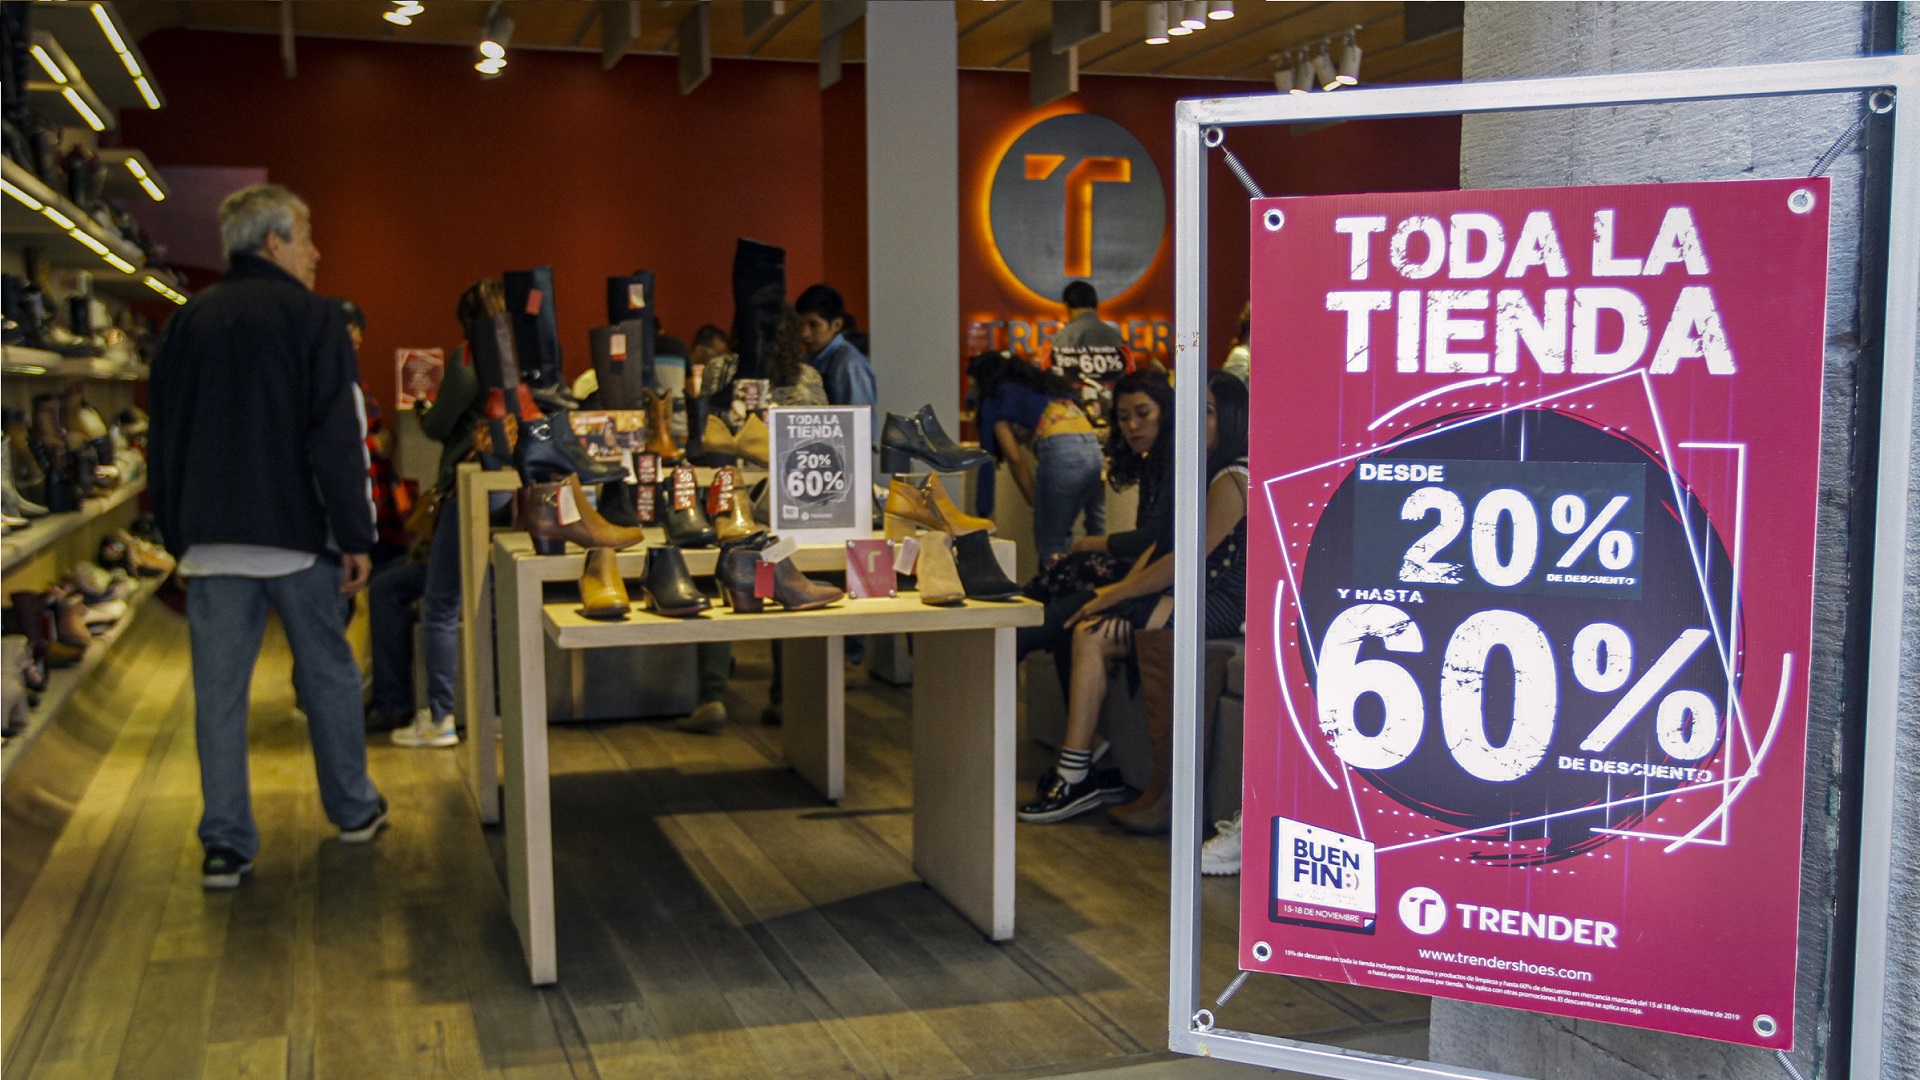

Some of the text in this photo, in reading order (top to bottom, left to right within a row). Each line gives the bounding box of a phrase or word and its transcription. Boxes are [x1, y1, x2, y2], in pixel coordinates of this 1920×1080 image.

[1335, 207, 1711, 280] TODA LA
[1326, 287, 1737, 375] TIENDA
[1079, 354, 1123, 374] 60%
[787, 425, 844, 438] TIENDA
[788, 414, 839, 425] TODA LA
[797, 454, 832, 468] 20%
[1360, 463, 1444, 482] DESDE
[787, 470, 844, 497] 60%
[1399, 487, 1633, 587] 20%
[1547, 574, 1635, 585] DE DESCUENTO
[1337, 589, 1424, 603] Y HASTA
[1317, 603, 1719, 782] 60%
[1558, 756, 1713, 784] DE DESCUENTO
[1294, 838, 1360, 870] BUEN
[1284, 905, 1360, 923] 15-18 DE NOVIEMBRE
[1456, 903, 1618, 948] TRENDER
[1418, 949, 1592, 982] www.trendershoes.com
[1304, 952, 1332, 961] descuento
[1376, 962, 1406, 971] incluyendo
[1406, 967, 1434, 976] accesorios
[1438, 972, 1466, 980] productos
[1474, 976, 1498, 985] limpieza
[1503, 980, 1519, 988] hasta
[1519, 982, 1532, 990] 60%
[1541, 986, 1572, 996] descuento
[1611, 996, 1637, 1005] marcada
[1680, 1006, 1714, 1016] noviembre
[1724, 1012, 1740, 1020] 2019
[1445, 980, 1464, 988] tienda.
[1518, 991, 1558, 1002] promociones.
[1564, 997, 1594, 1007] descuento
[1602, 1003, 1620, 1011] aplica
